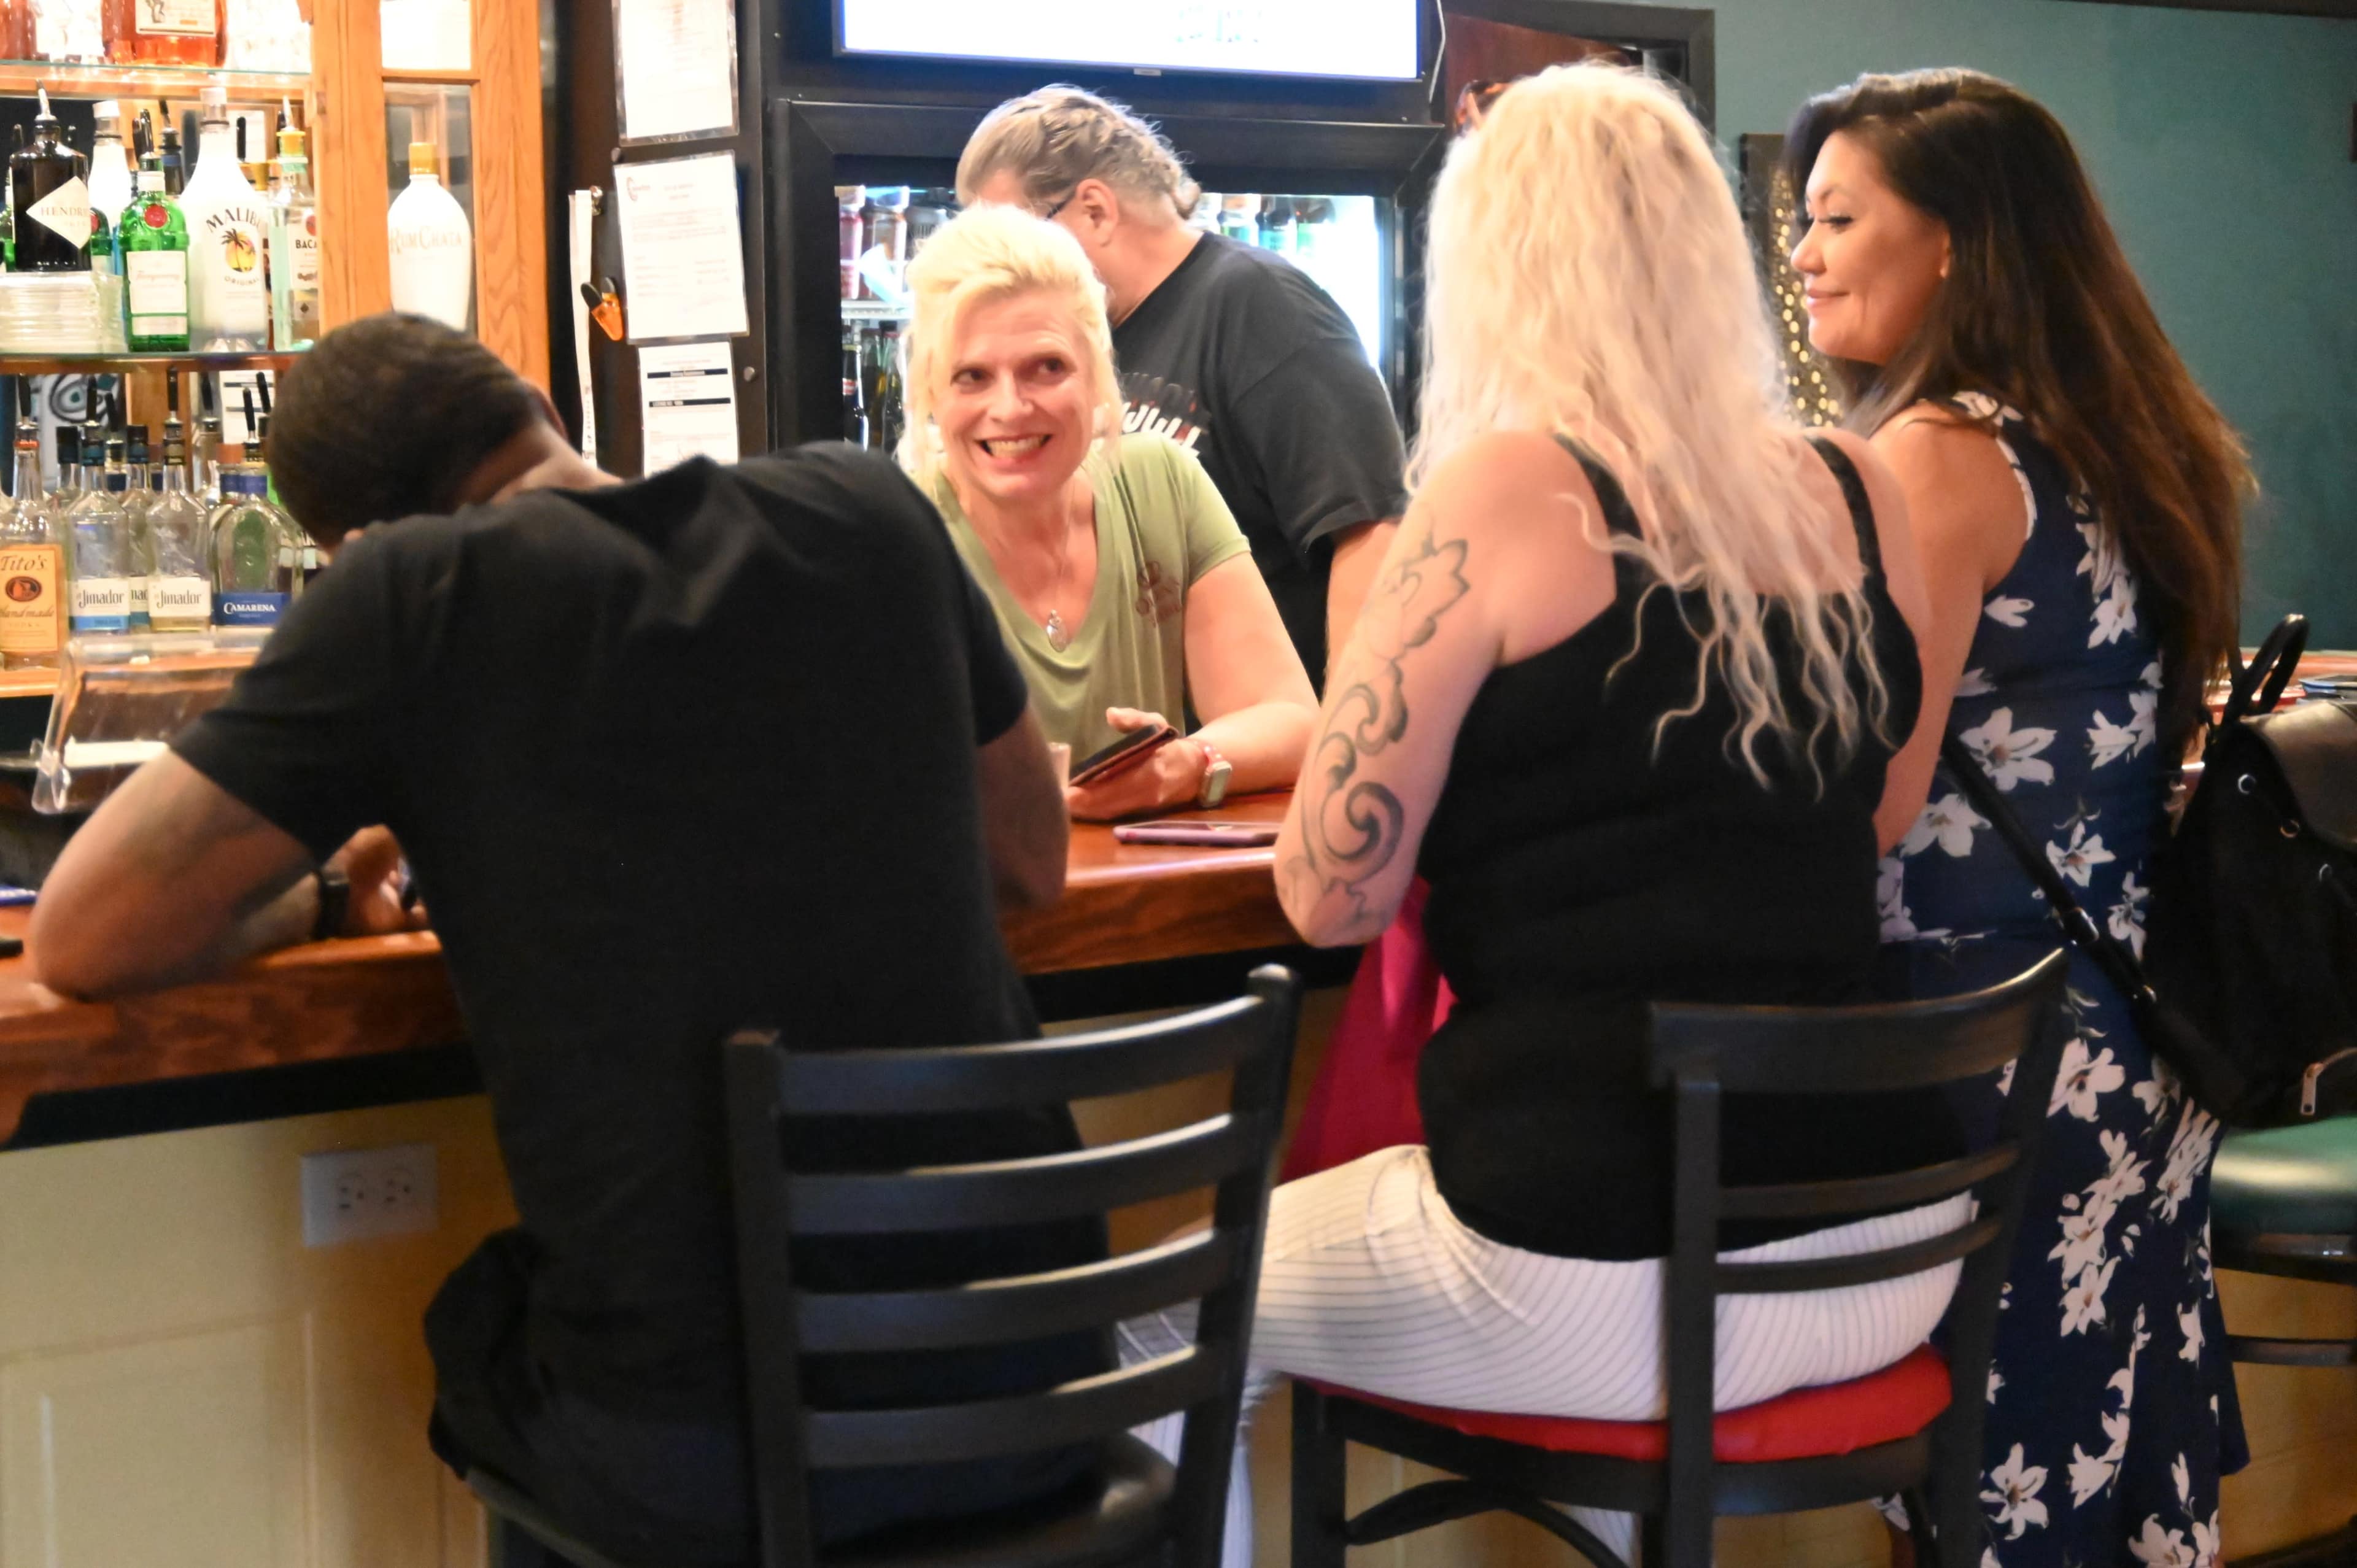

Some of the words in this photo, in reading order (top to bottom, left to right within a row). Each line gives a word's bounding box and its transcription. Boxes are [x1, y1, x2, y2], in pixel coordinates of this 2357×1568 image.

[1, 555, 47, 571] Tito's
[79, 589, 125, 608] Jimador
[157, 589, 201, 609] Jimador
